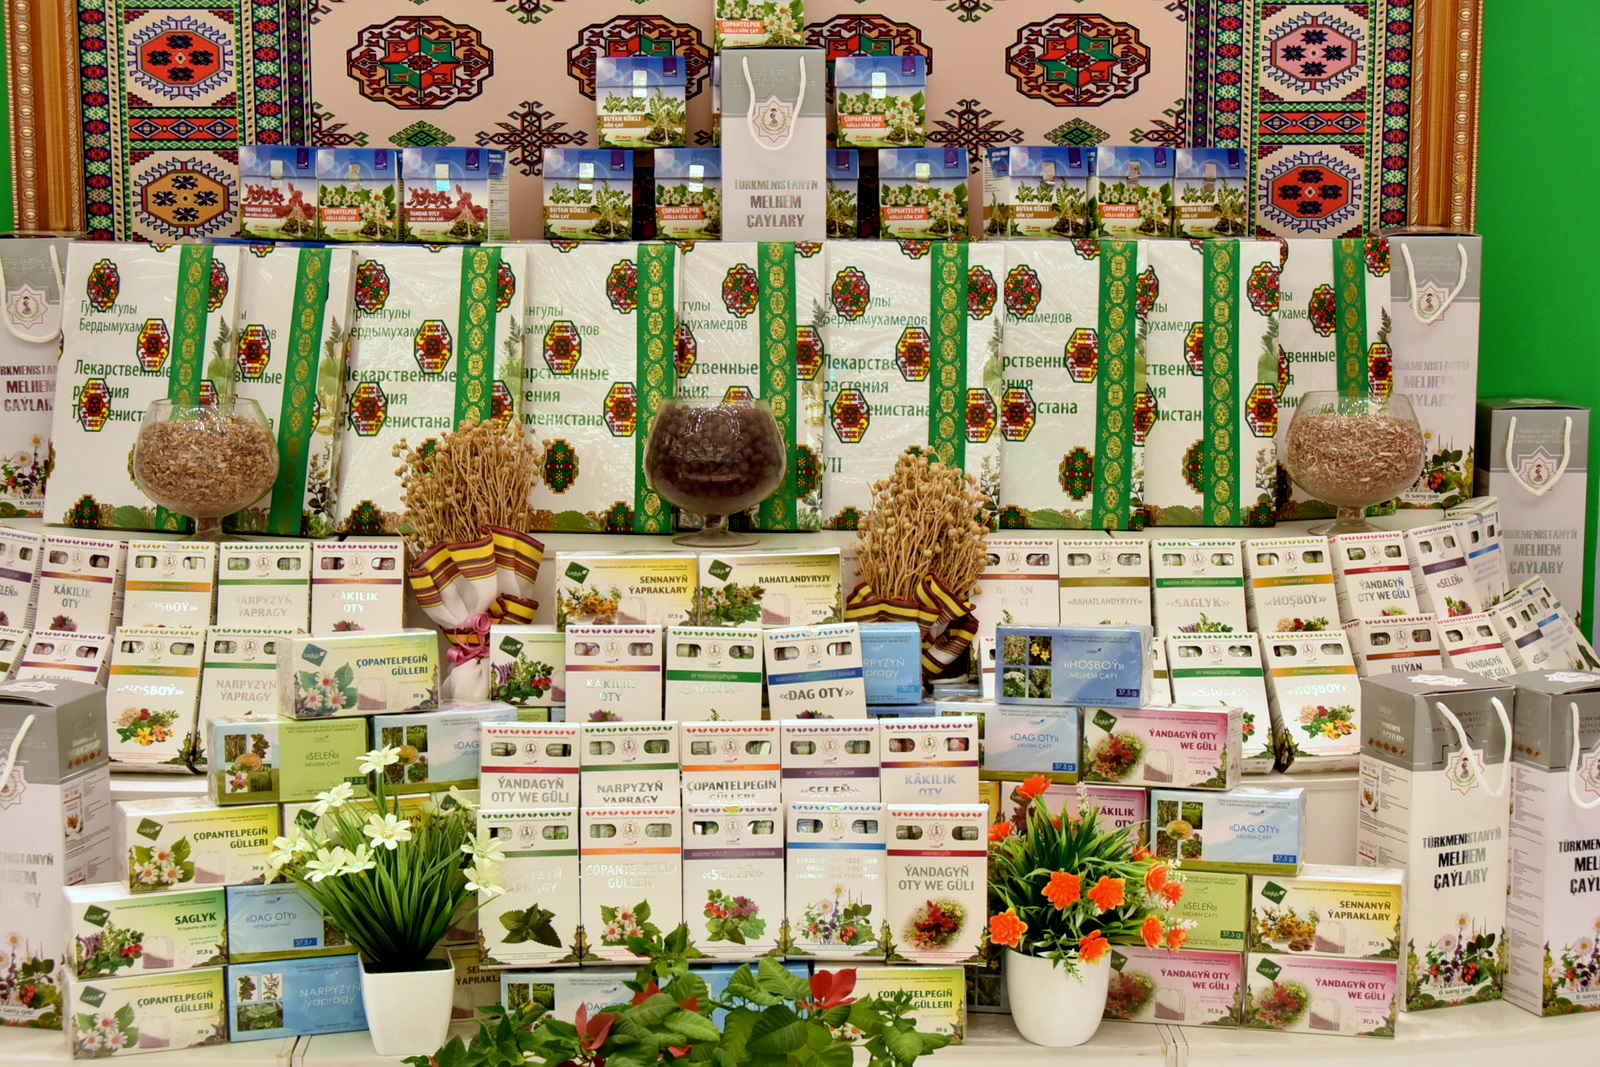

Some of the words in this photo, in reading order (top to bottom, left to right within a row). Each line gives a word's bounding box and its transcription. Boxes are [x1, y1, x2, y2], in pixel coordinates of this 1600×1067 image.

[750, 195, 802, 209] MELHEM
[661, 207, 700, 215] ÇOPANTELPEK
[746, 212, 805, 229] ÇAÝLARY
[81, 300, 138, 317] Гурнгулы
[682, 318, 748, 332] мухамедов
[1005, 312, 1073, 326] мухамедов
[79, 318, 144, 335] Бердымухам
[824, 354, 898, 373] Лекарстве
[1513, 543, 1562, 556] MELHEM
[639, 575, 688, 584] SENNANYŇ
[758, 574, 831, 585] RAHATLANDYRYJY
[1359, 576, 1405, 591] ÝANDAGYŇ
[1357, 591, 1375, 603] OTY
[1377, 589, 1391, 601] WE
[62, 598, 80, 609] OTY
[344, 603, 366, 613] OTY
[356, 654, 429, 669] ÇOPANTELPEGIŇ
[864, 656, 905, 668] RPYZYŇ
[1063, 659, 1125, 671] «HOŞBOÝ»
[391, 666, 429, 677] GÜLLERI
[779, 688, 816, 702] «DAG
[818, 687, 855, 699] OTY»
[1010, 733, 1036, 742] «DAG
[1037, 734, 1059, 742] OTY»
[1149, 728, 1198, 740] ÝANDAGYŇ
[1199, 732, 1218, 740] OTY
[1180, 742, 1195, 750] WE
[1196, 742, 1217, 751] GÜLI
[305, 749, 340, 761] «SELEŇ»
[498, 776, 564, 790] ÝANDAGYŇ
[905, 772, 957, 785] KÄKILIK
[597, 780, 664, 794] NARPYZYŇ
[491, 791, 516, 803] OTY
[518, 792, 539, 803] WE
[542, 790, 570, 804] GÜLI
[193, 826, 269, 842] ÇOPANTELPEGIŇ
[1229, 823, 1256, 833] «DAG
[1257, 825, 1280, 834] OTY»
[230, 839, 269, 849] GÜLLERI
[1422, 826, 1502, 849] TÜRKMENISTANYŇ
[1558, 839, 1600, 853] TÜRKMEN
[1438, 847, 1486, 868] MELHEM
[904, 864, 969, 878] ÝANDAGYŇ
[1574, 856, 1600, 873] MEL
[898, 880, 922, 891] OTY
[924, 880, 944, 891] WE
[946, 878, 975, 891] GÜLI
[1434, 867, 1489, 891] ÇAÝLARY
[1570, 875, 1600, 896] ÇAÝL
[1184, 902, 1218, 912] «SELEŇ»
[1339, 900, 1391, 911] SENNANYŇ
[175, 912, 217, 925] SAGLYK
[246, 914, 272, 924] «DAG
[274, 912, 297, 921] OTY»
[1327, 909, 1391, 921] ÝAPRAKLARY
[1160, 967, 1210, 979] ÝANDAGYŇ
[1212, 972, 1230, 980] OTY
[1192, 981, 1207, 989] WE
[1208, 981, 1230, 991] GÜLI
[1315, 976, 1366, 989] ÝANDAGYŇ
[1368, 982, 1386, 990] OTY
[137, 990, 214, 1008] ÇOPANTELPEGIŇ
[1347, 991, 1362, 999] WE
[1364, 991, 1386, 1001] GÜLI
[1444, 989, 1460, 997] sany
[174, 1001, 214, 1014] GÜLLERI
[914, 999, 953, 1009] GÜLLERI
